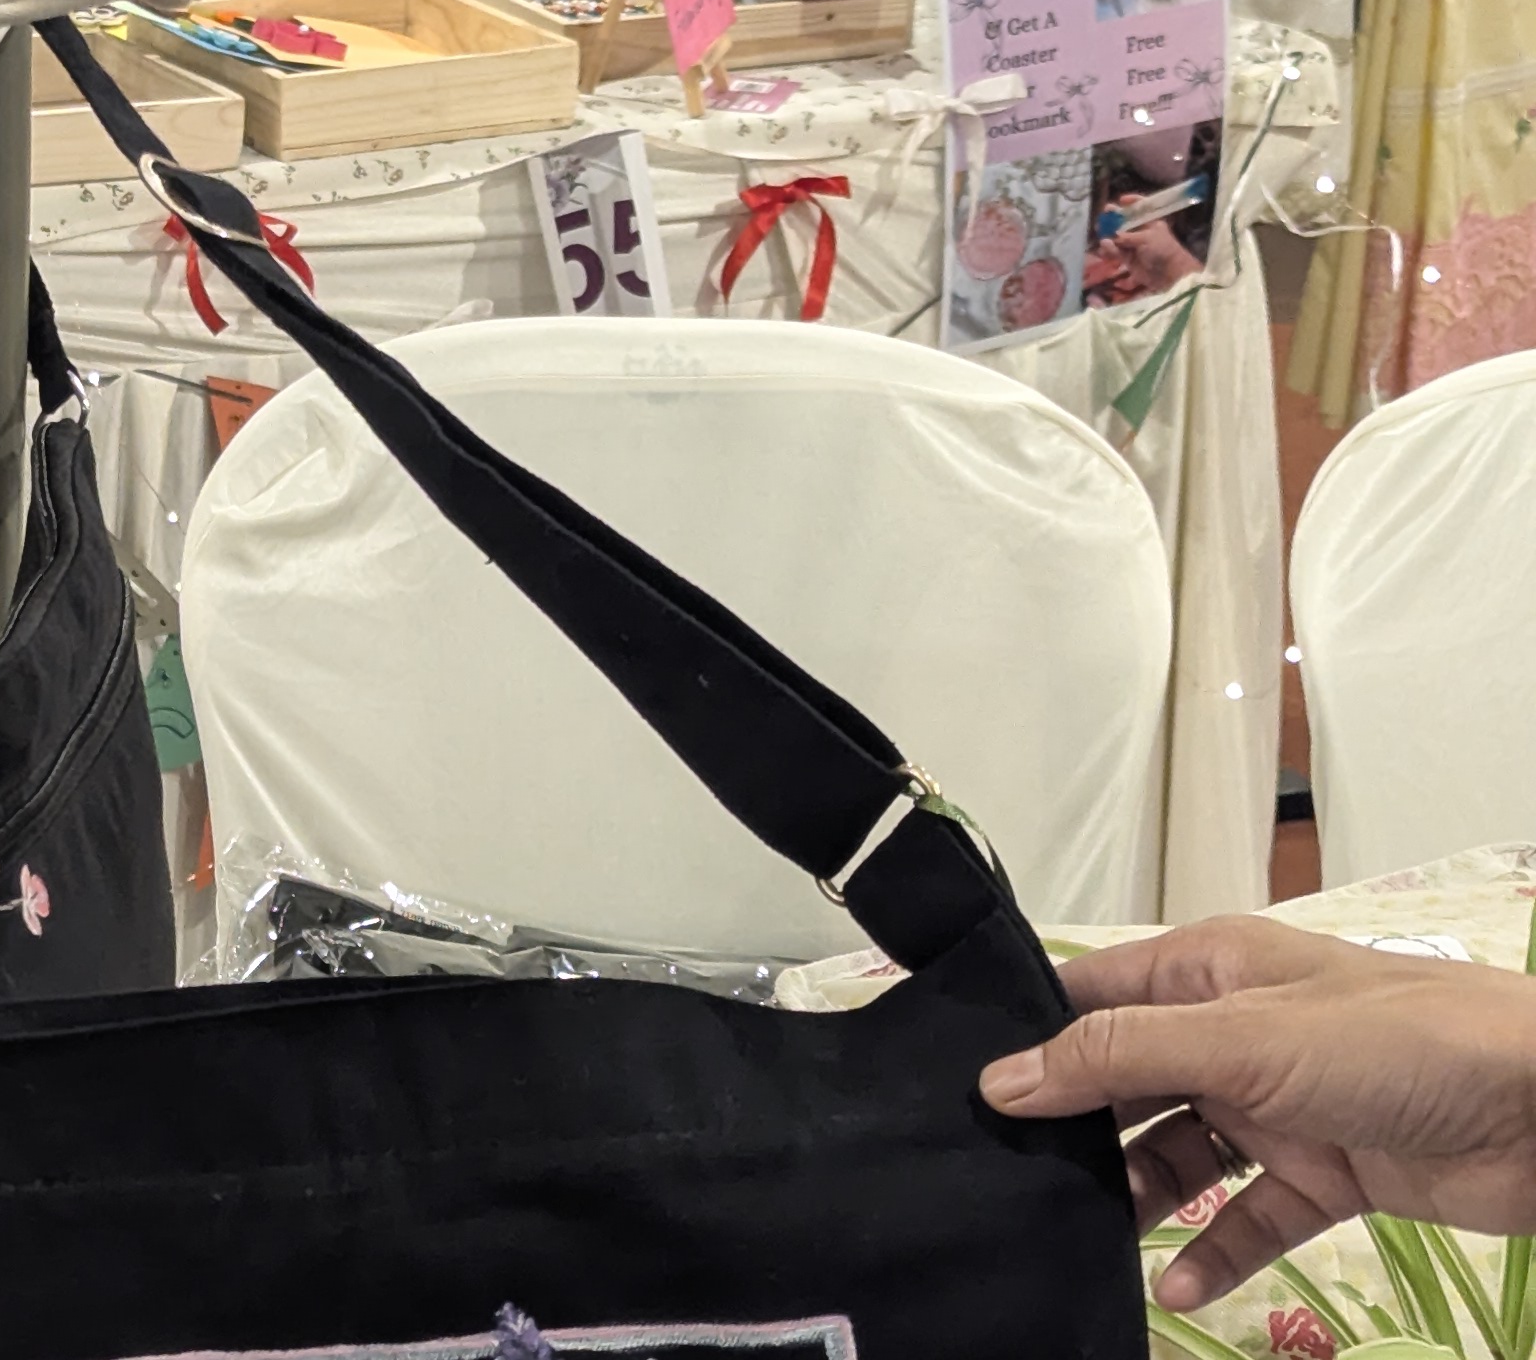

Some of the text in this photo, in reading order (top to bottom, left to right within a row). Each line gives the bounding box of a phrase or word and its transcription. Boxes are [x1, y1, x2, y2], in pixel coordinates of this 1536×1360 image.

[1007, 18, 1039, 36] Get
[1044, 11, 1058, 29] A
[1126, 35, 1166, 53] Free
[986, 48, 1057, 72] Coaster
[1127, 67, 1166, 85] Free
[988, 107, 1070, 138] ookmark
